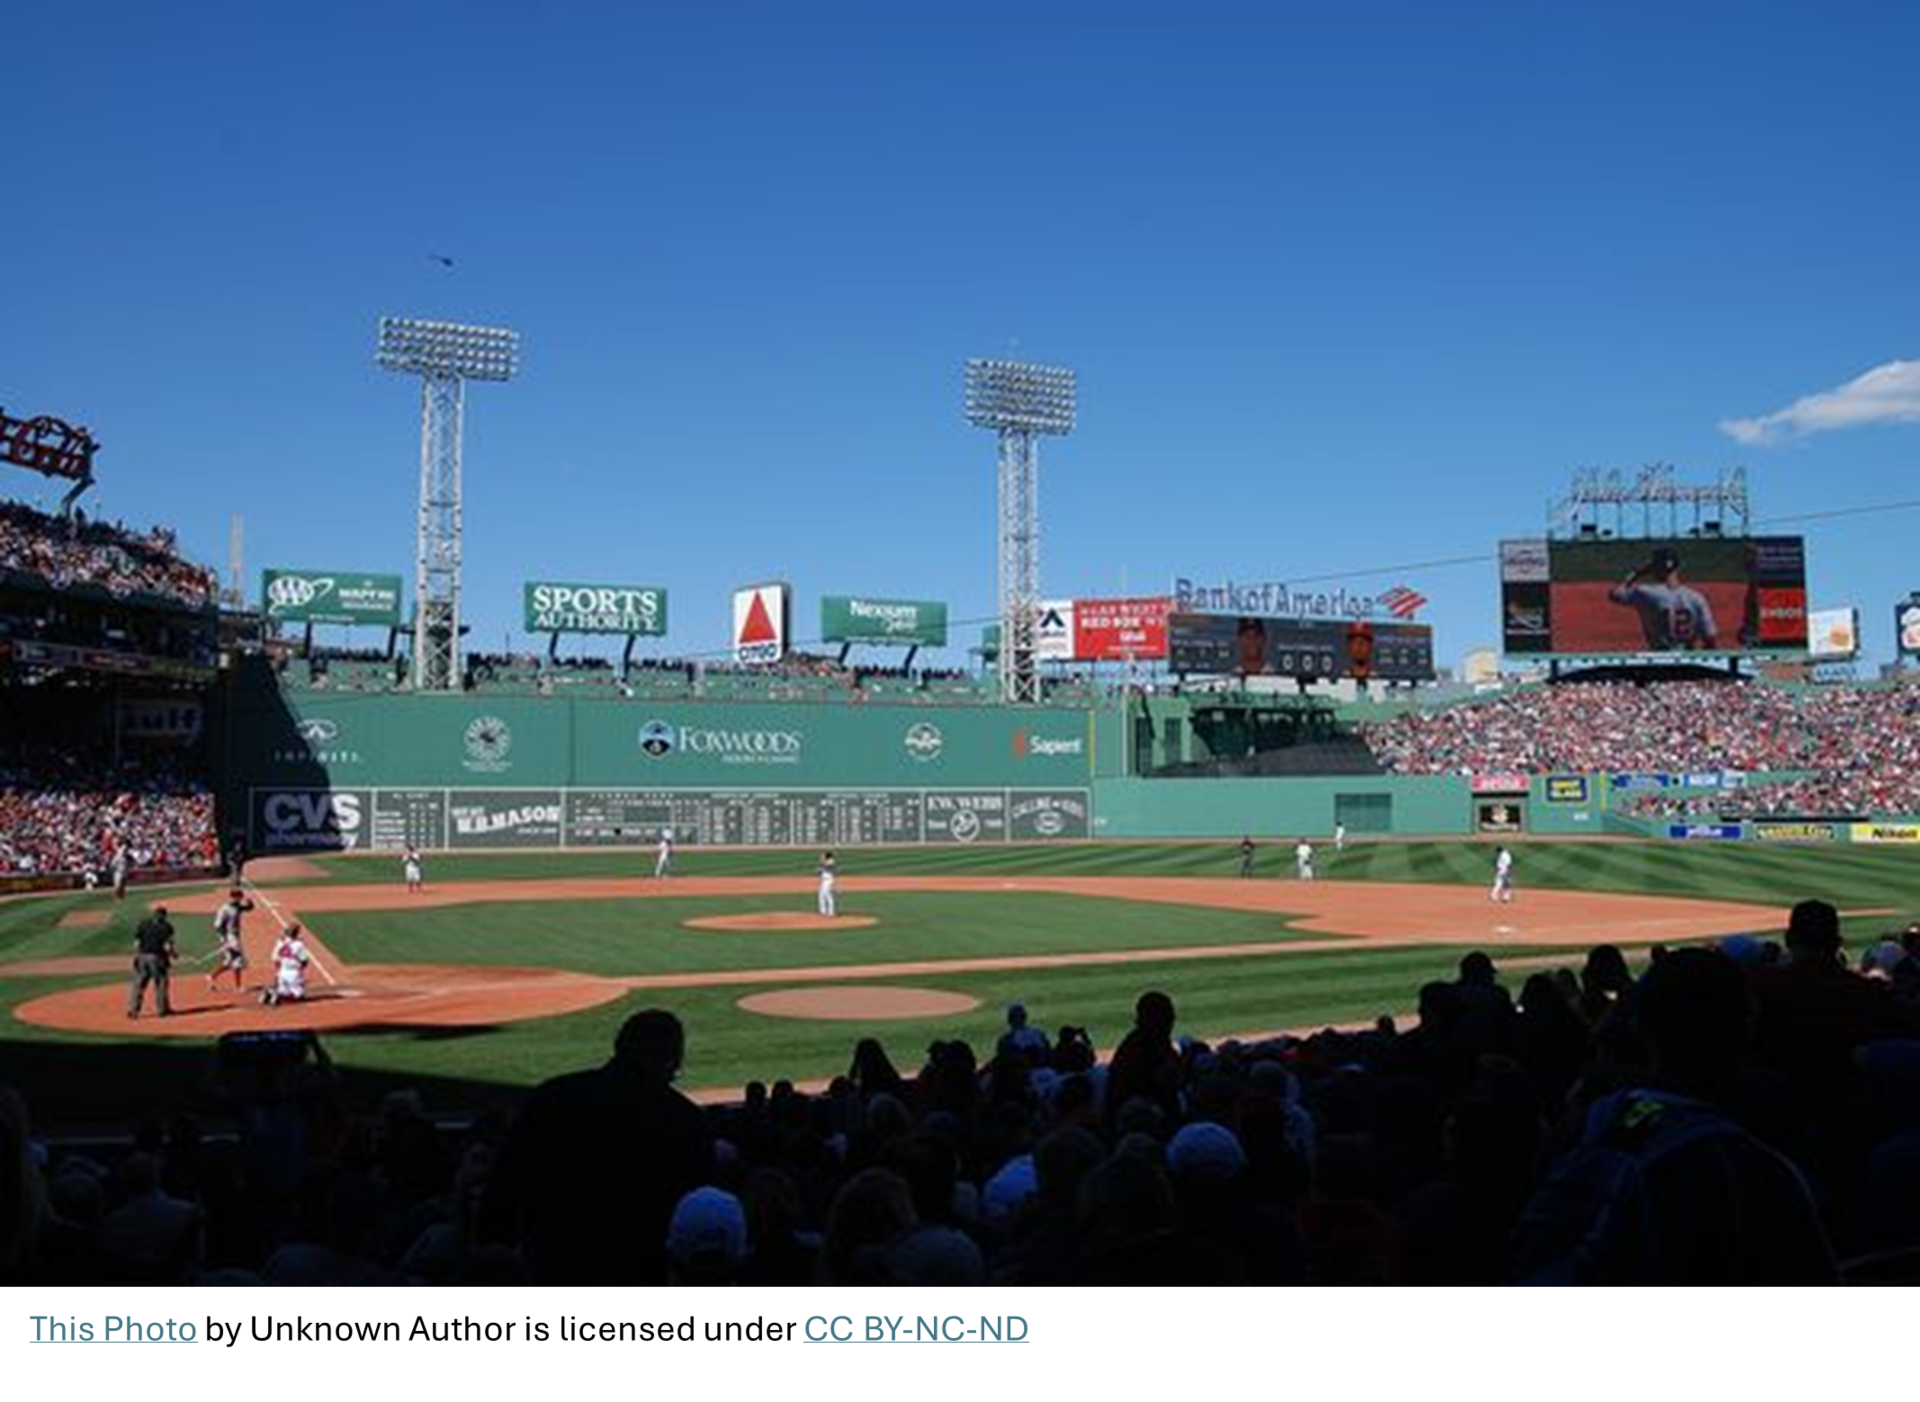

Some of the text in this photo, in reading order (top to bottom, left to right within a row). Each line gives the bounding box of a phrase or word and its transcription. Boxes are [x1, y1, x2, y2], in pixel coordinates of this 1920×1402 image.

[533, 585, 658, 615] SPORTS
[1176, 578, 1242, 612] Bank
[1242, 584, 1274, 612] of
[1275, 584, 1375, 616] America
[534, 612, 658, 631] AUTHORITY
[263, 793, 362, 830] CVS
